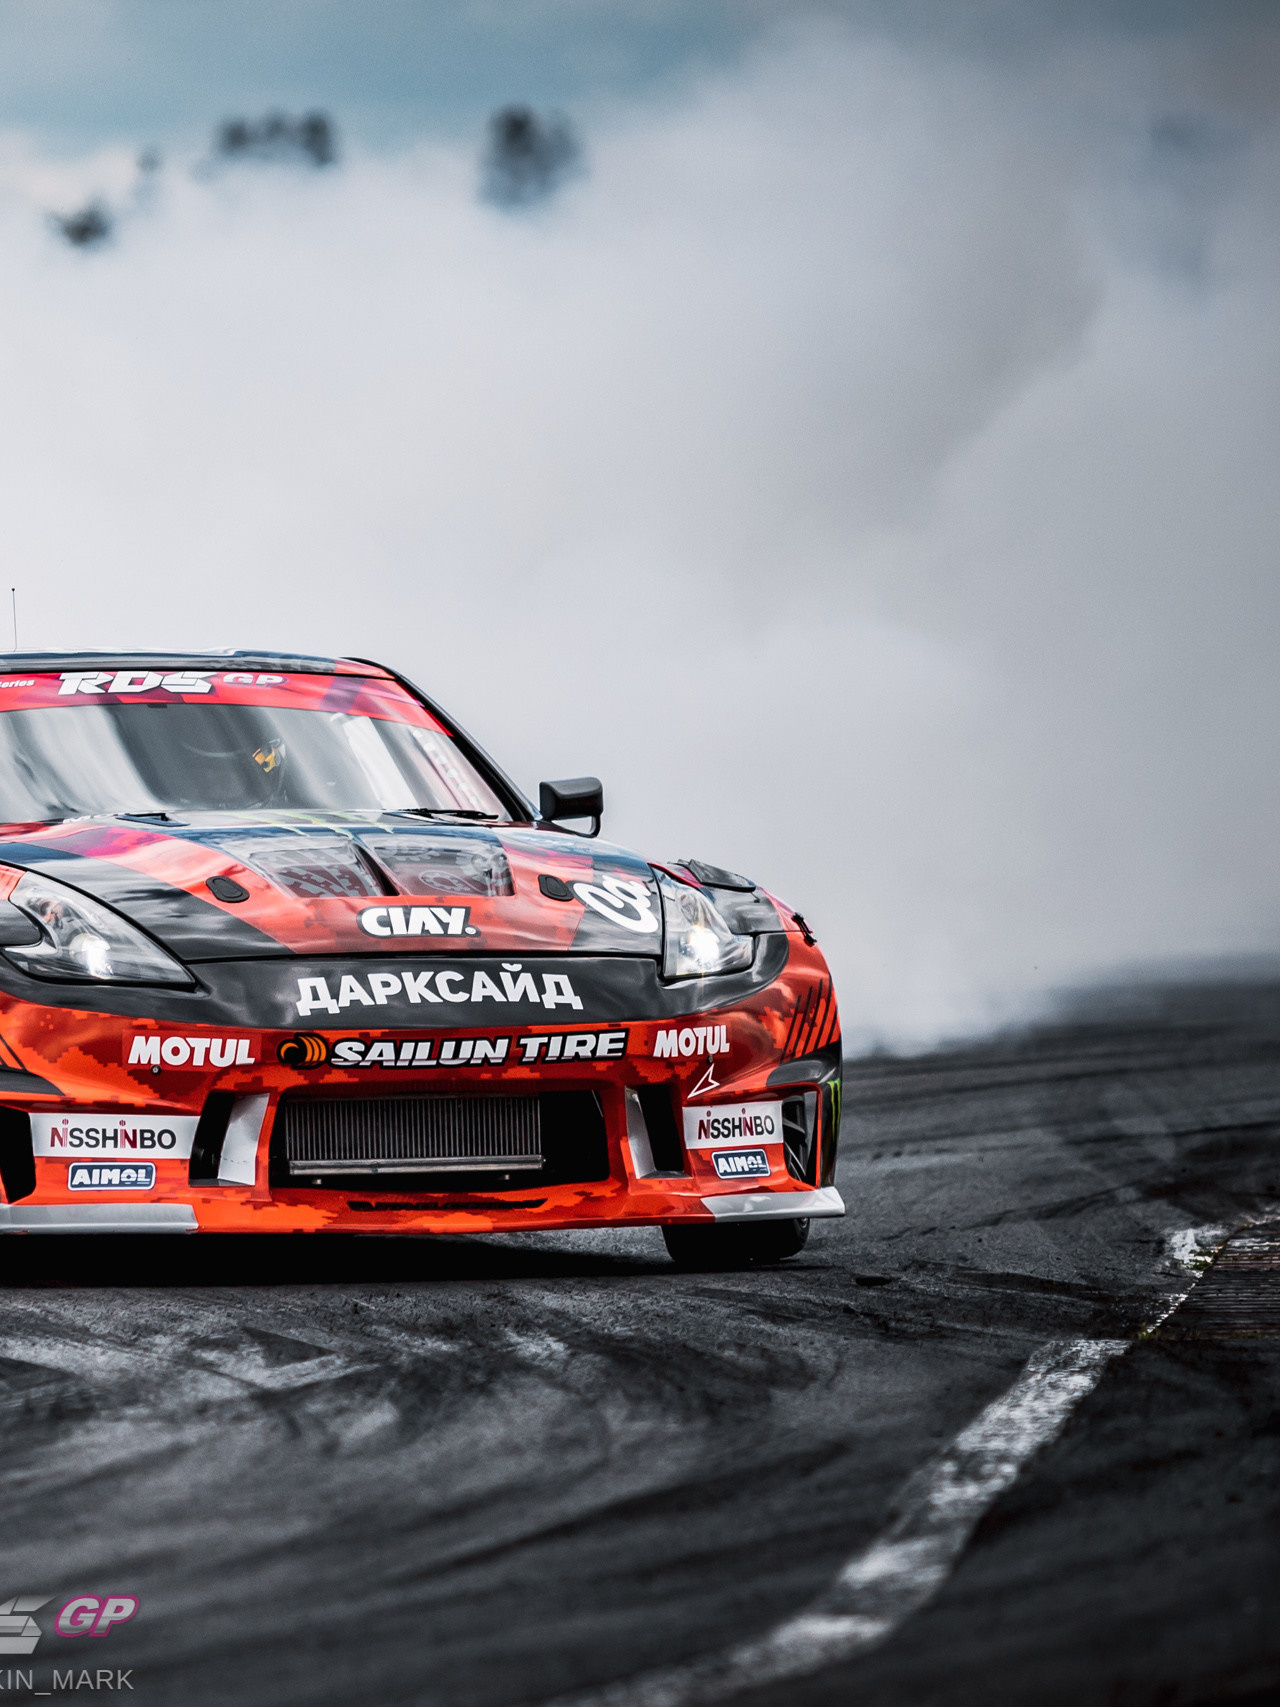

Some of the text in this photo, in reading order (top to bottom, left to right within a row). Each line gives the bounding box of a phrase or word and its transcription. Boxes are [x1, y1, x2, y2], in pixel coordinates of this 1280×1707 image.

[58, 671, 285, 695] RDS GP
[296, 963, 583, 1016] ДАРКСАЙД
[128, 1036, 256, 1066] MOTUL
[331, 1032, 626, 1067] SAILUN TIRE
[653, 1025, 730, 1058] MOTUL
[72, 1169, 151, 1185] AIMOL
[718, 1155, 767, 1174] AIMOL
